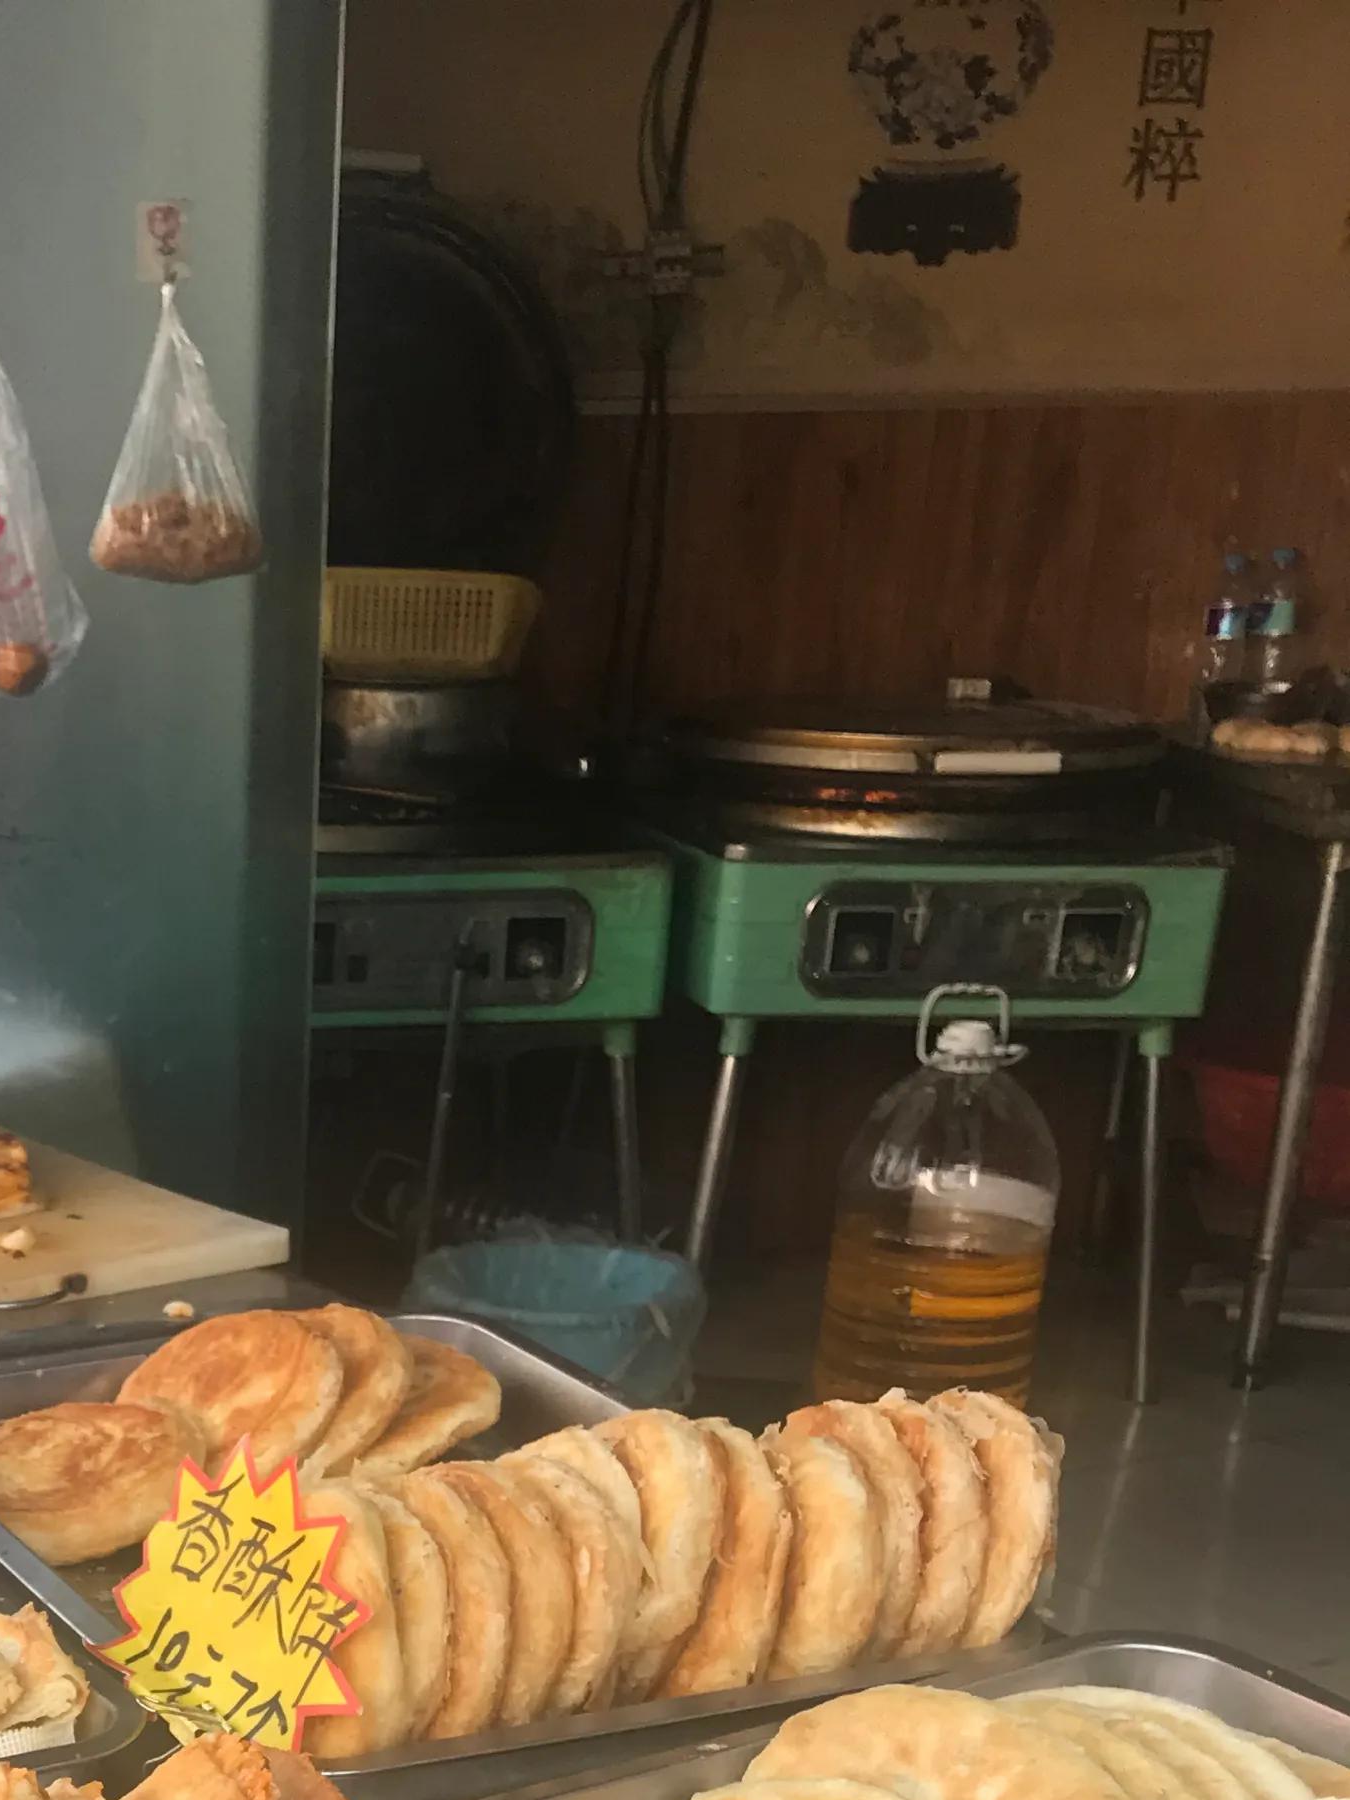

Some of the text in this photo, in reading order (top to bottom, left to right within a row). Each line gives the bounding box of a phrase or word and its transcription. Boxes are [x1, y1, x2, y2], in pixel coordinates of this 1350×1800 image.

[1122, 0, 1214, 202] 國粹
[171, 1473, 359, 1707] 香酥饼
